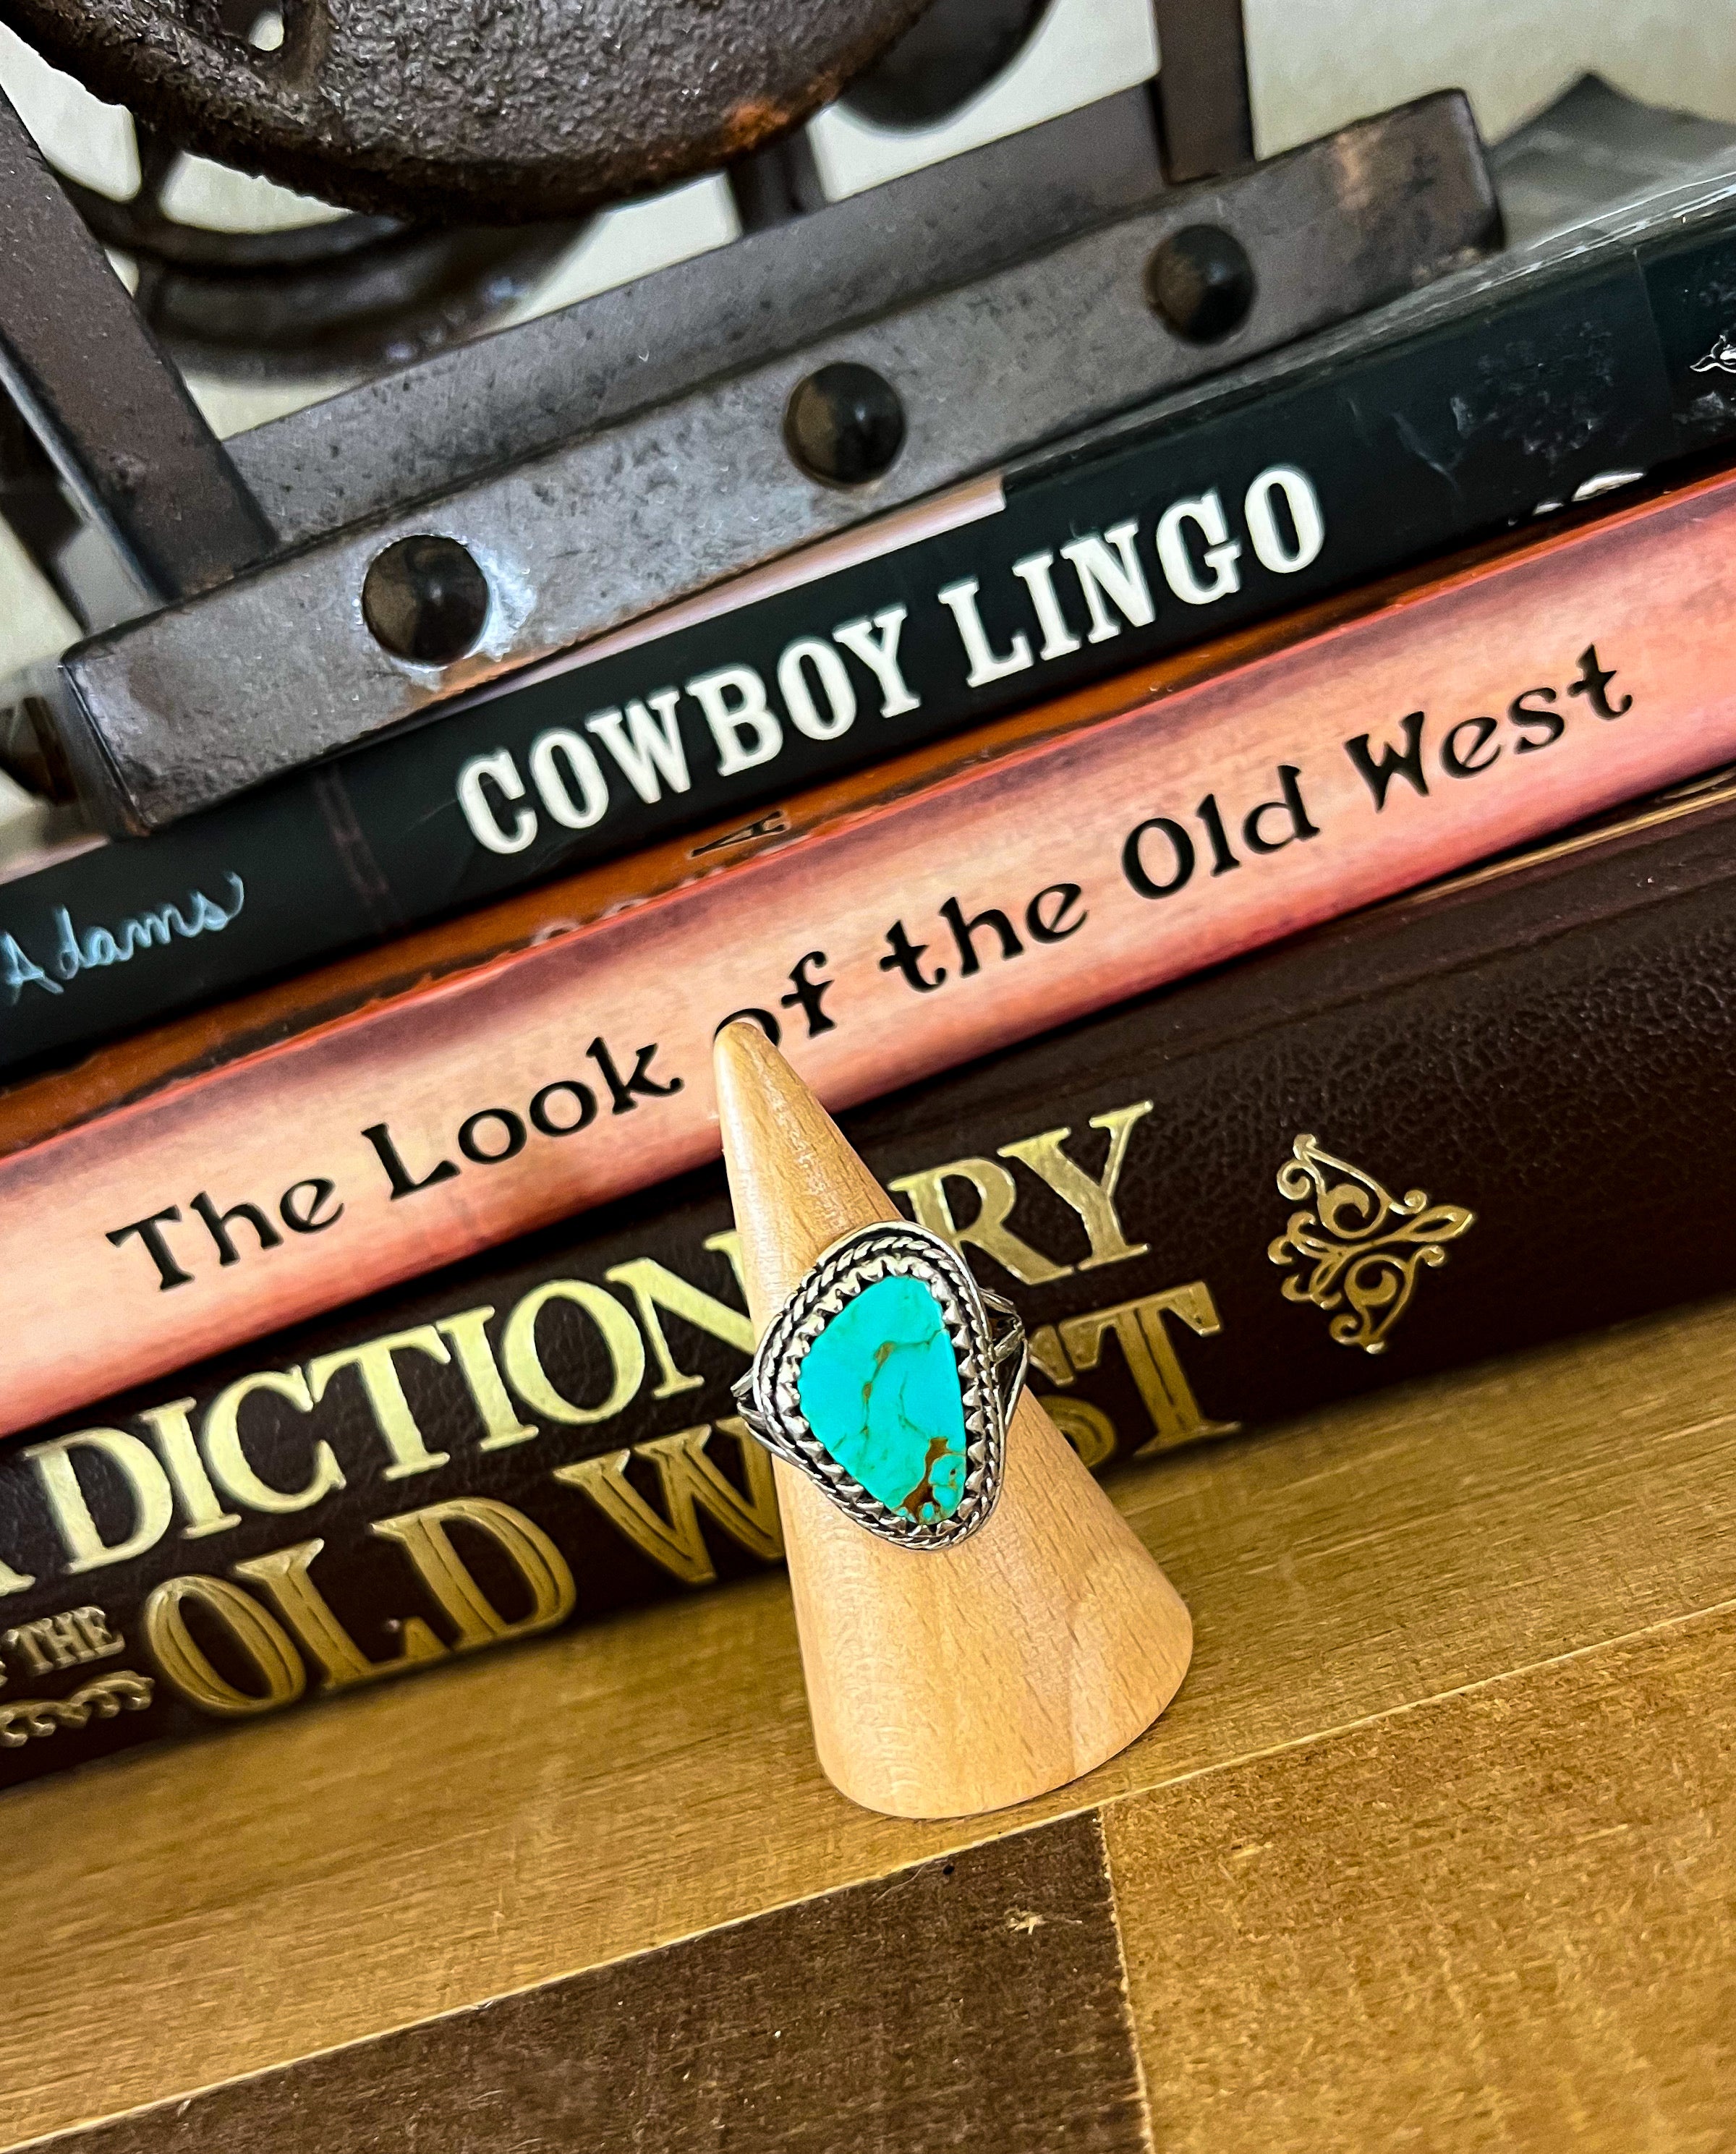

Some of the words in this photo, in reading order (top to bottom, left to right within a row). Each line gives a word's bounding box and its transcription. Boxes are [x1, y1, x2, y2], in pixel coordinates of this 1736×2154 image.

[456, 603, 921, 855] COWBOY
[938, 464, 1326, 688] LINGO
[0, 871, 245, 1005] Adams
[105, 1177, 345, 1291] The
[360, 1036, 685, 1201] Look
[878, 882, 1089, 993] the
[1122, 765, 1320, 900] Old
[1344, 642, 1634, 814] West
[22, 1100, 1154, 1575] DICTIONRY
[2, 1605, 126, 1677] THE
[145, 1497, 577, 1719] OLD
